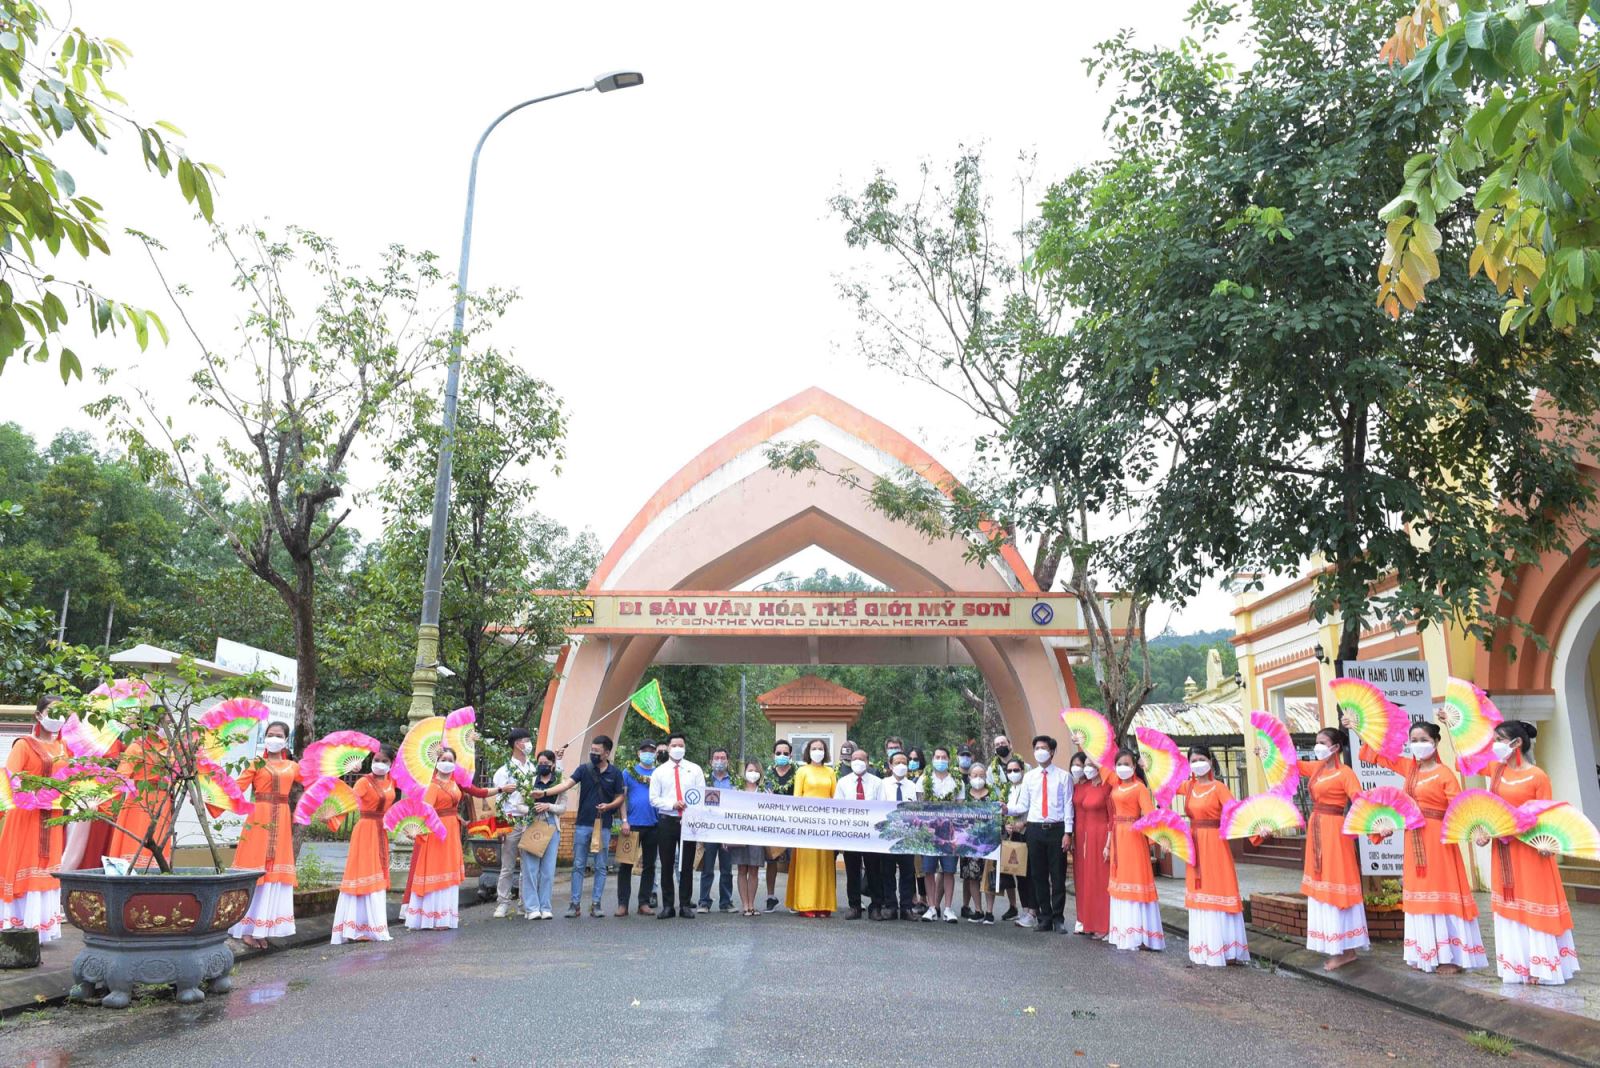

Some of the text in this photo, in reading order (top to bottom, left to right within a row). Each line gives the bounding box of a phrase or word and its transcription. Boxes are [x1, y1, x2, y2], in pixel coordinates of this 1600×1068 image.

[619, 602, 642, 615] DI
[759, 599, 806, 616] HÓA
[918, 600, 956, 617] MỸ
[962, 602, 1011, 617] SƠN
[751, 618, 805, 626] WORLD
[808, 618, 889, 627] CULTURAL
[893, 619, 969, 627] HERITAGE
[757, 802, 791, 811] WARMLY
[791, 804, 831, 813] WELCOME
[724, 812, 786, 822] INTERNATIONAL
[788, 816, 826, 825] TOURISTS
[828, 818, 838, 826] TO
[687, 821, 871, 839] WORLD CULTURAL HERITAGE IN PILOT PROGRAM
